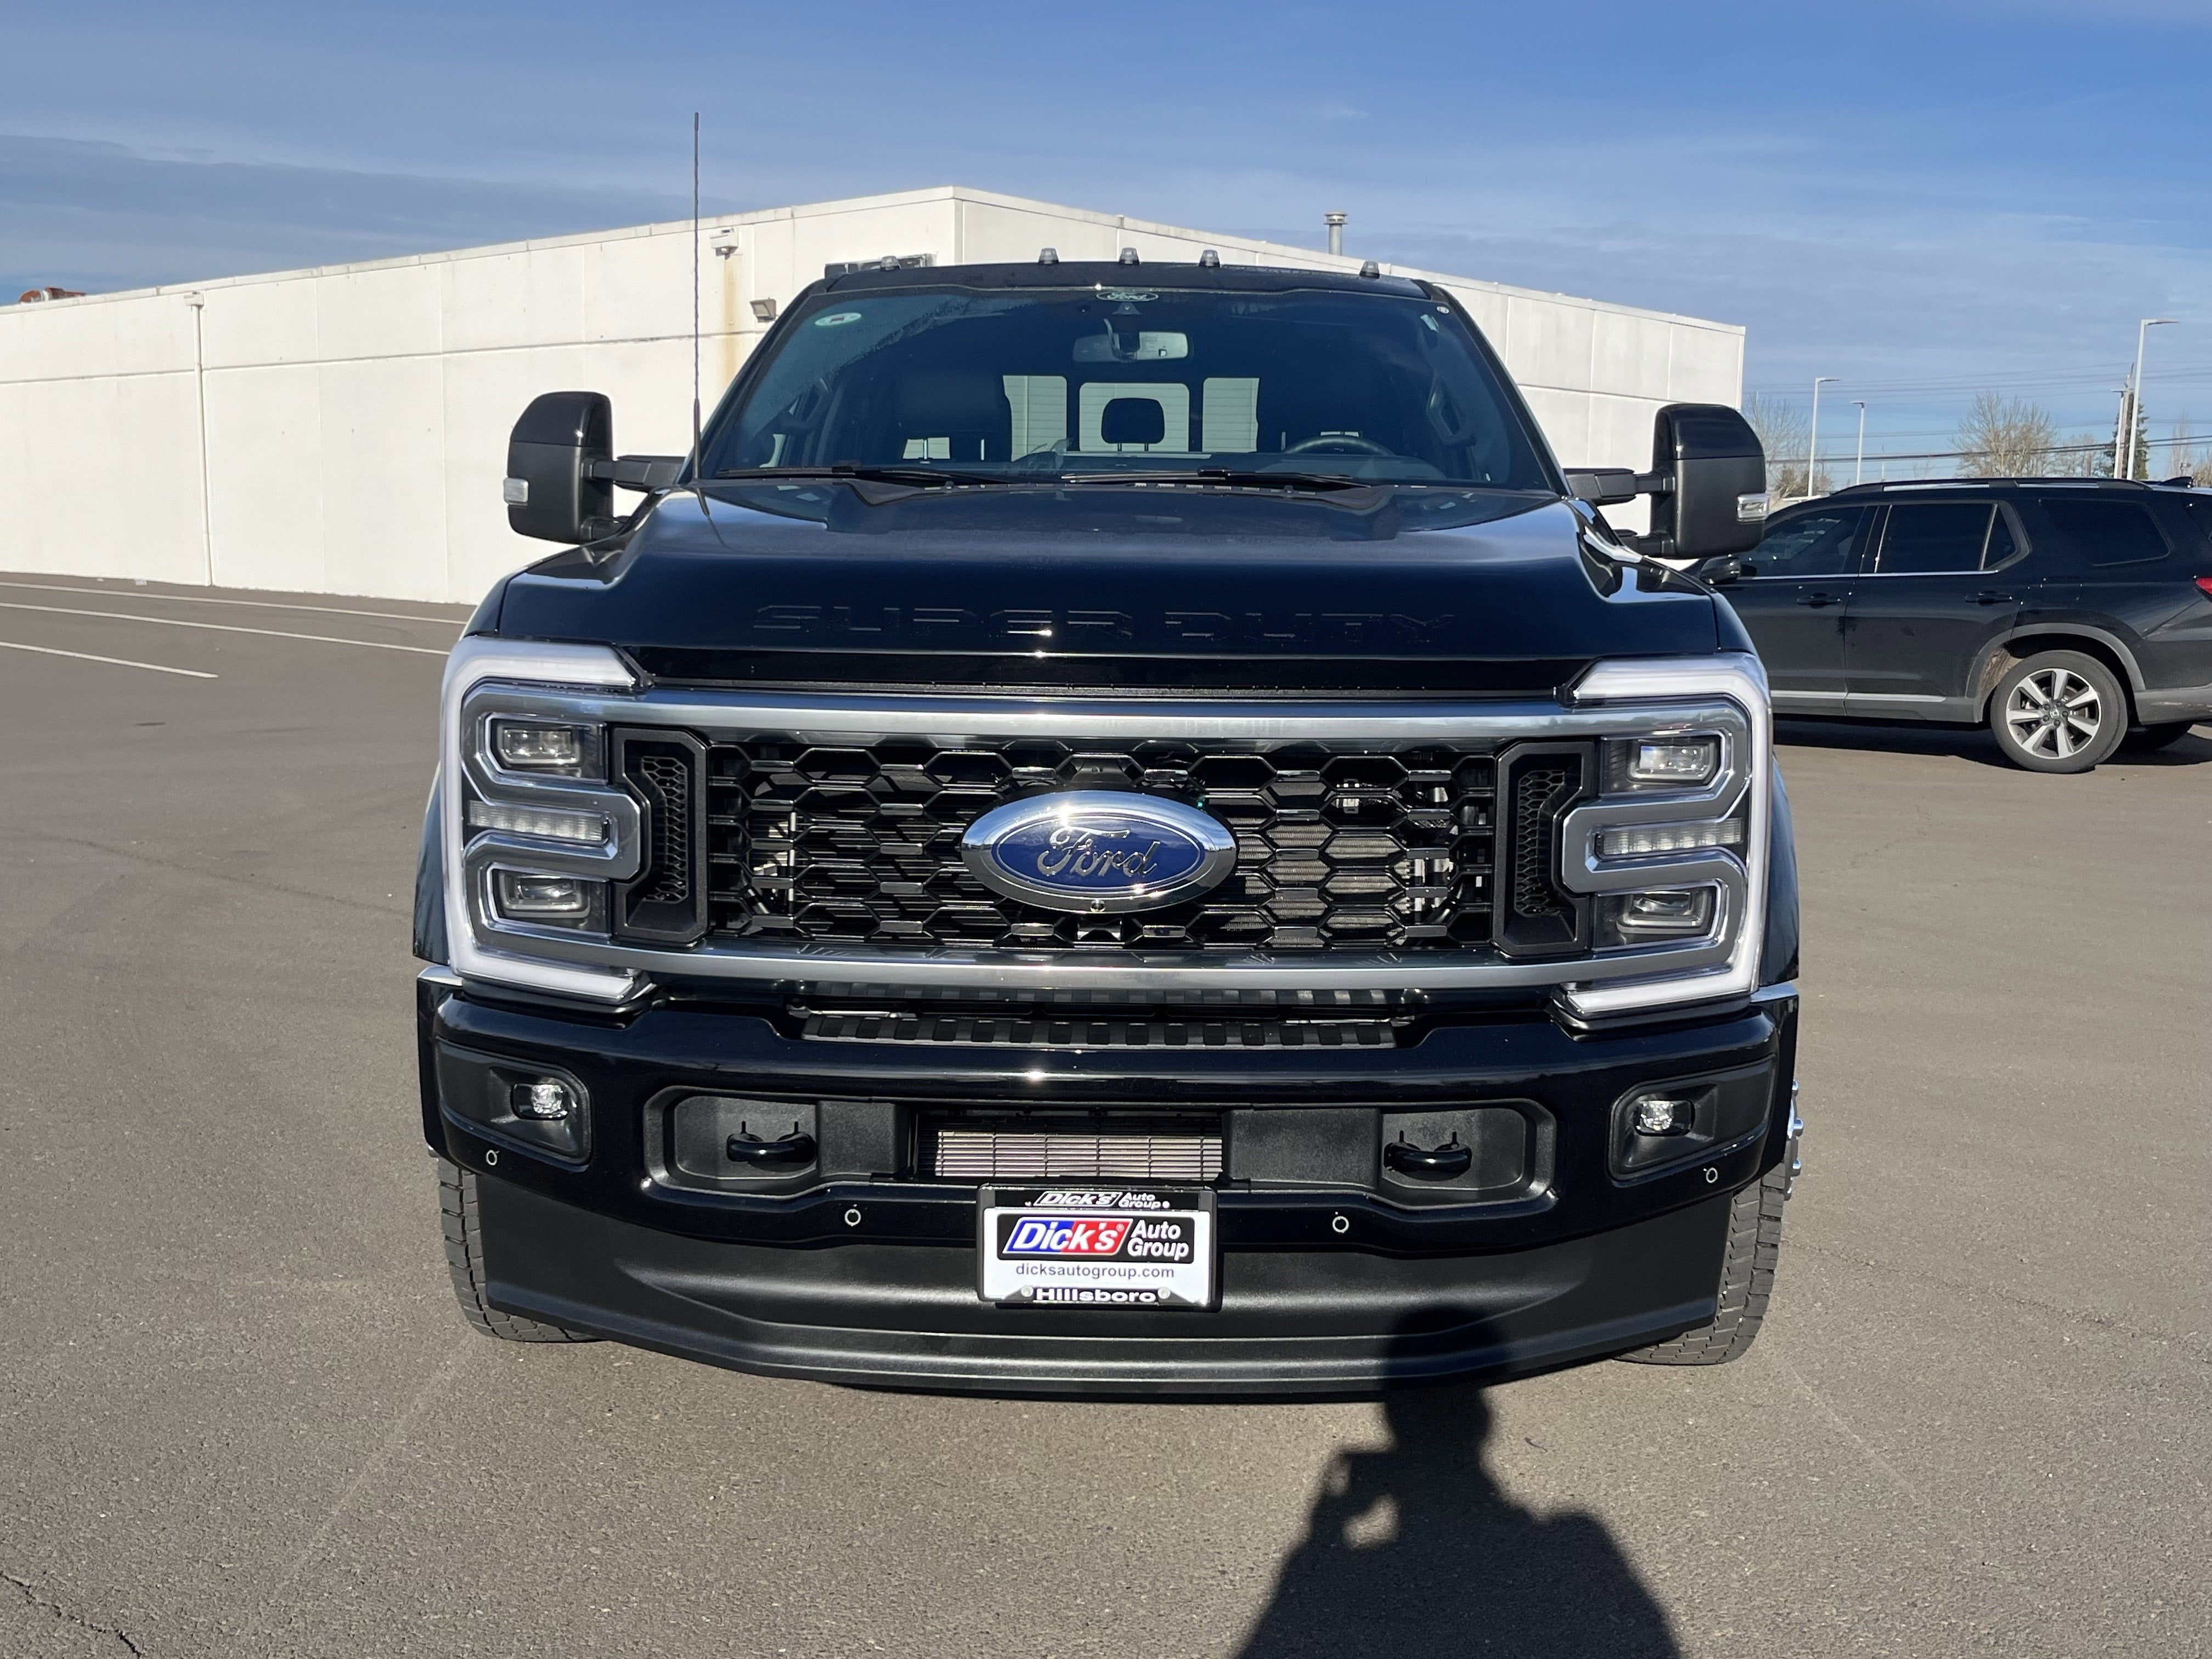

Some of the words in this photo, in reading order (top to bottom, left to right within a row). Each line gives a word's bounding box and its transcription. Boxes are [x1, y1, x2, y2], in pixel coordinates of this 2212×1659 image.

[752, 605, 1132, 637] SUPER
[1163, 611, 1456, 643] DUTY
[1037, 826, 1161, 877] Ford
[1118, 1200, 1161, 1209] Group
[1124, 1193, 1156, 1201] Auto
[1131, 1220, 1181, 1239] Auto
[1127, 1238, 1189, 1261] Group
[1015, 1263, 1175, 1280] dicksautogroup.com
[1036, 1288, 1157, 1303] Hillsboro
